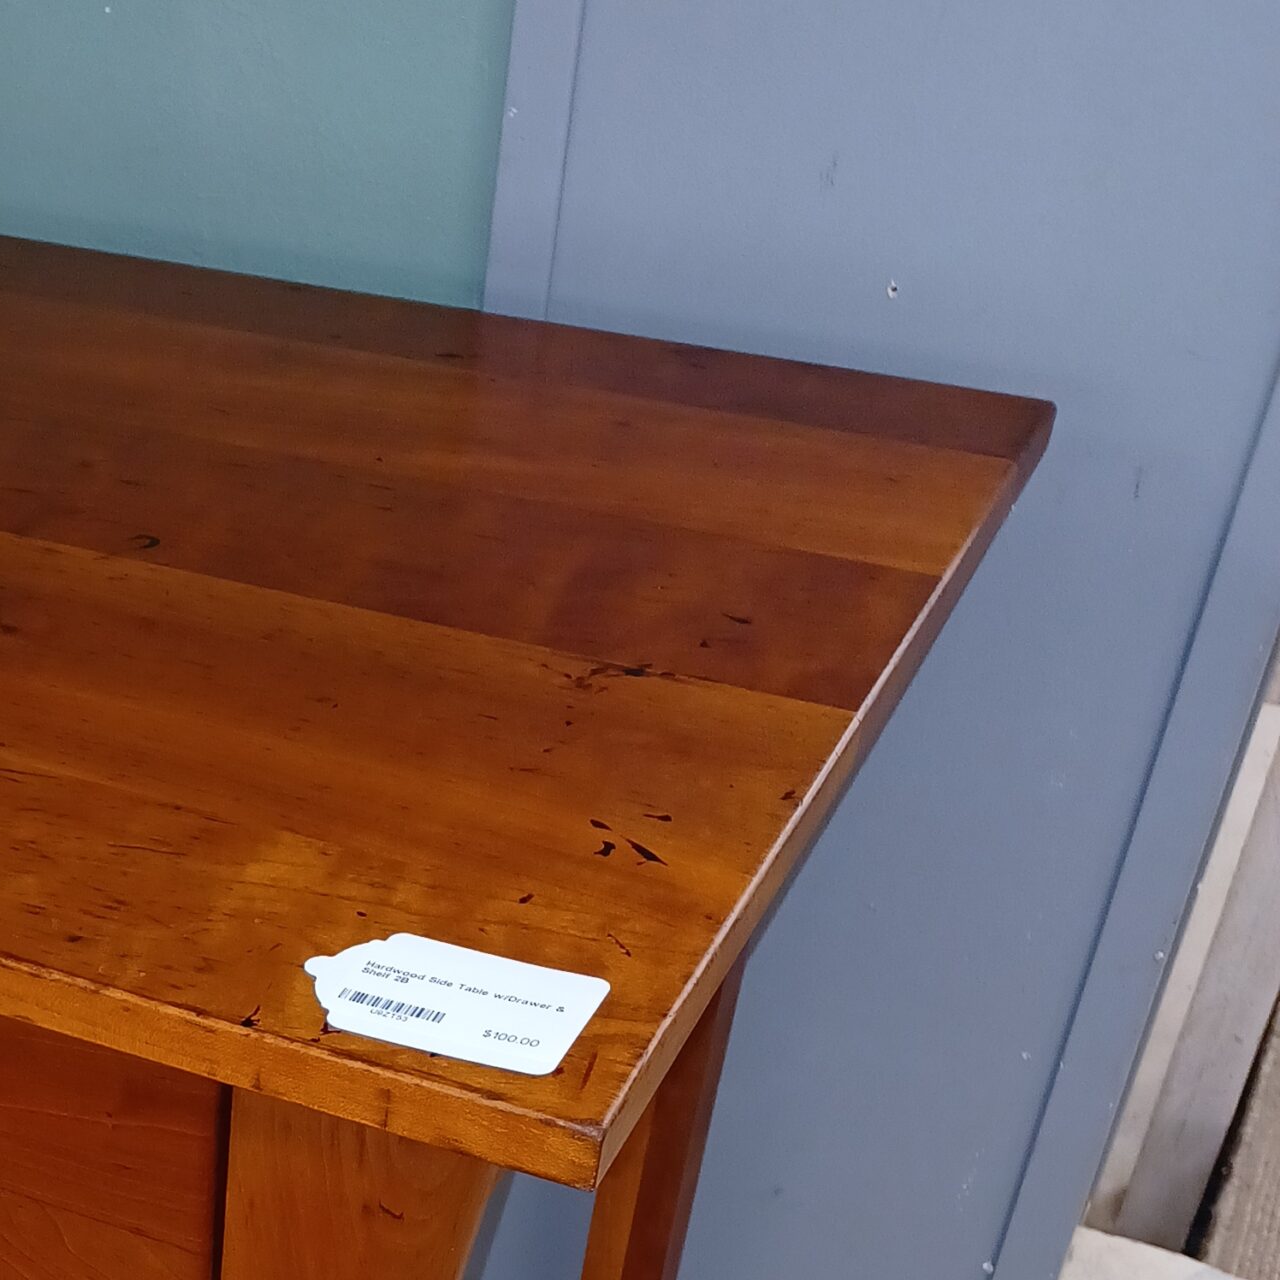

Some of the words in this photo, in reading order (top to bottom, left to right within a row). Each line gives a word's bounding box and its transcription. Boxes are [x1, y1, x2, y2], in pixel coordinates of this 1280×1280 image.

[361, 967, 391, 979] Shelf
[393, 975, 410, 984] 2B
[366, 960, 426, 981] Hardwood
[428, 976, 453, 987] Side
[458, 983, 489, 996] Table
[493, 993, 552, 1010] w/Drawer
[482, 1029, 540, 1048] $100.00
